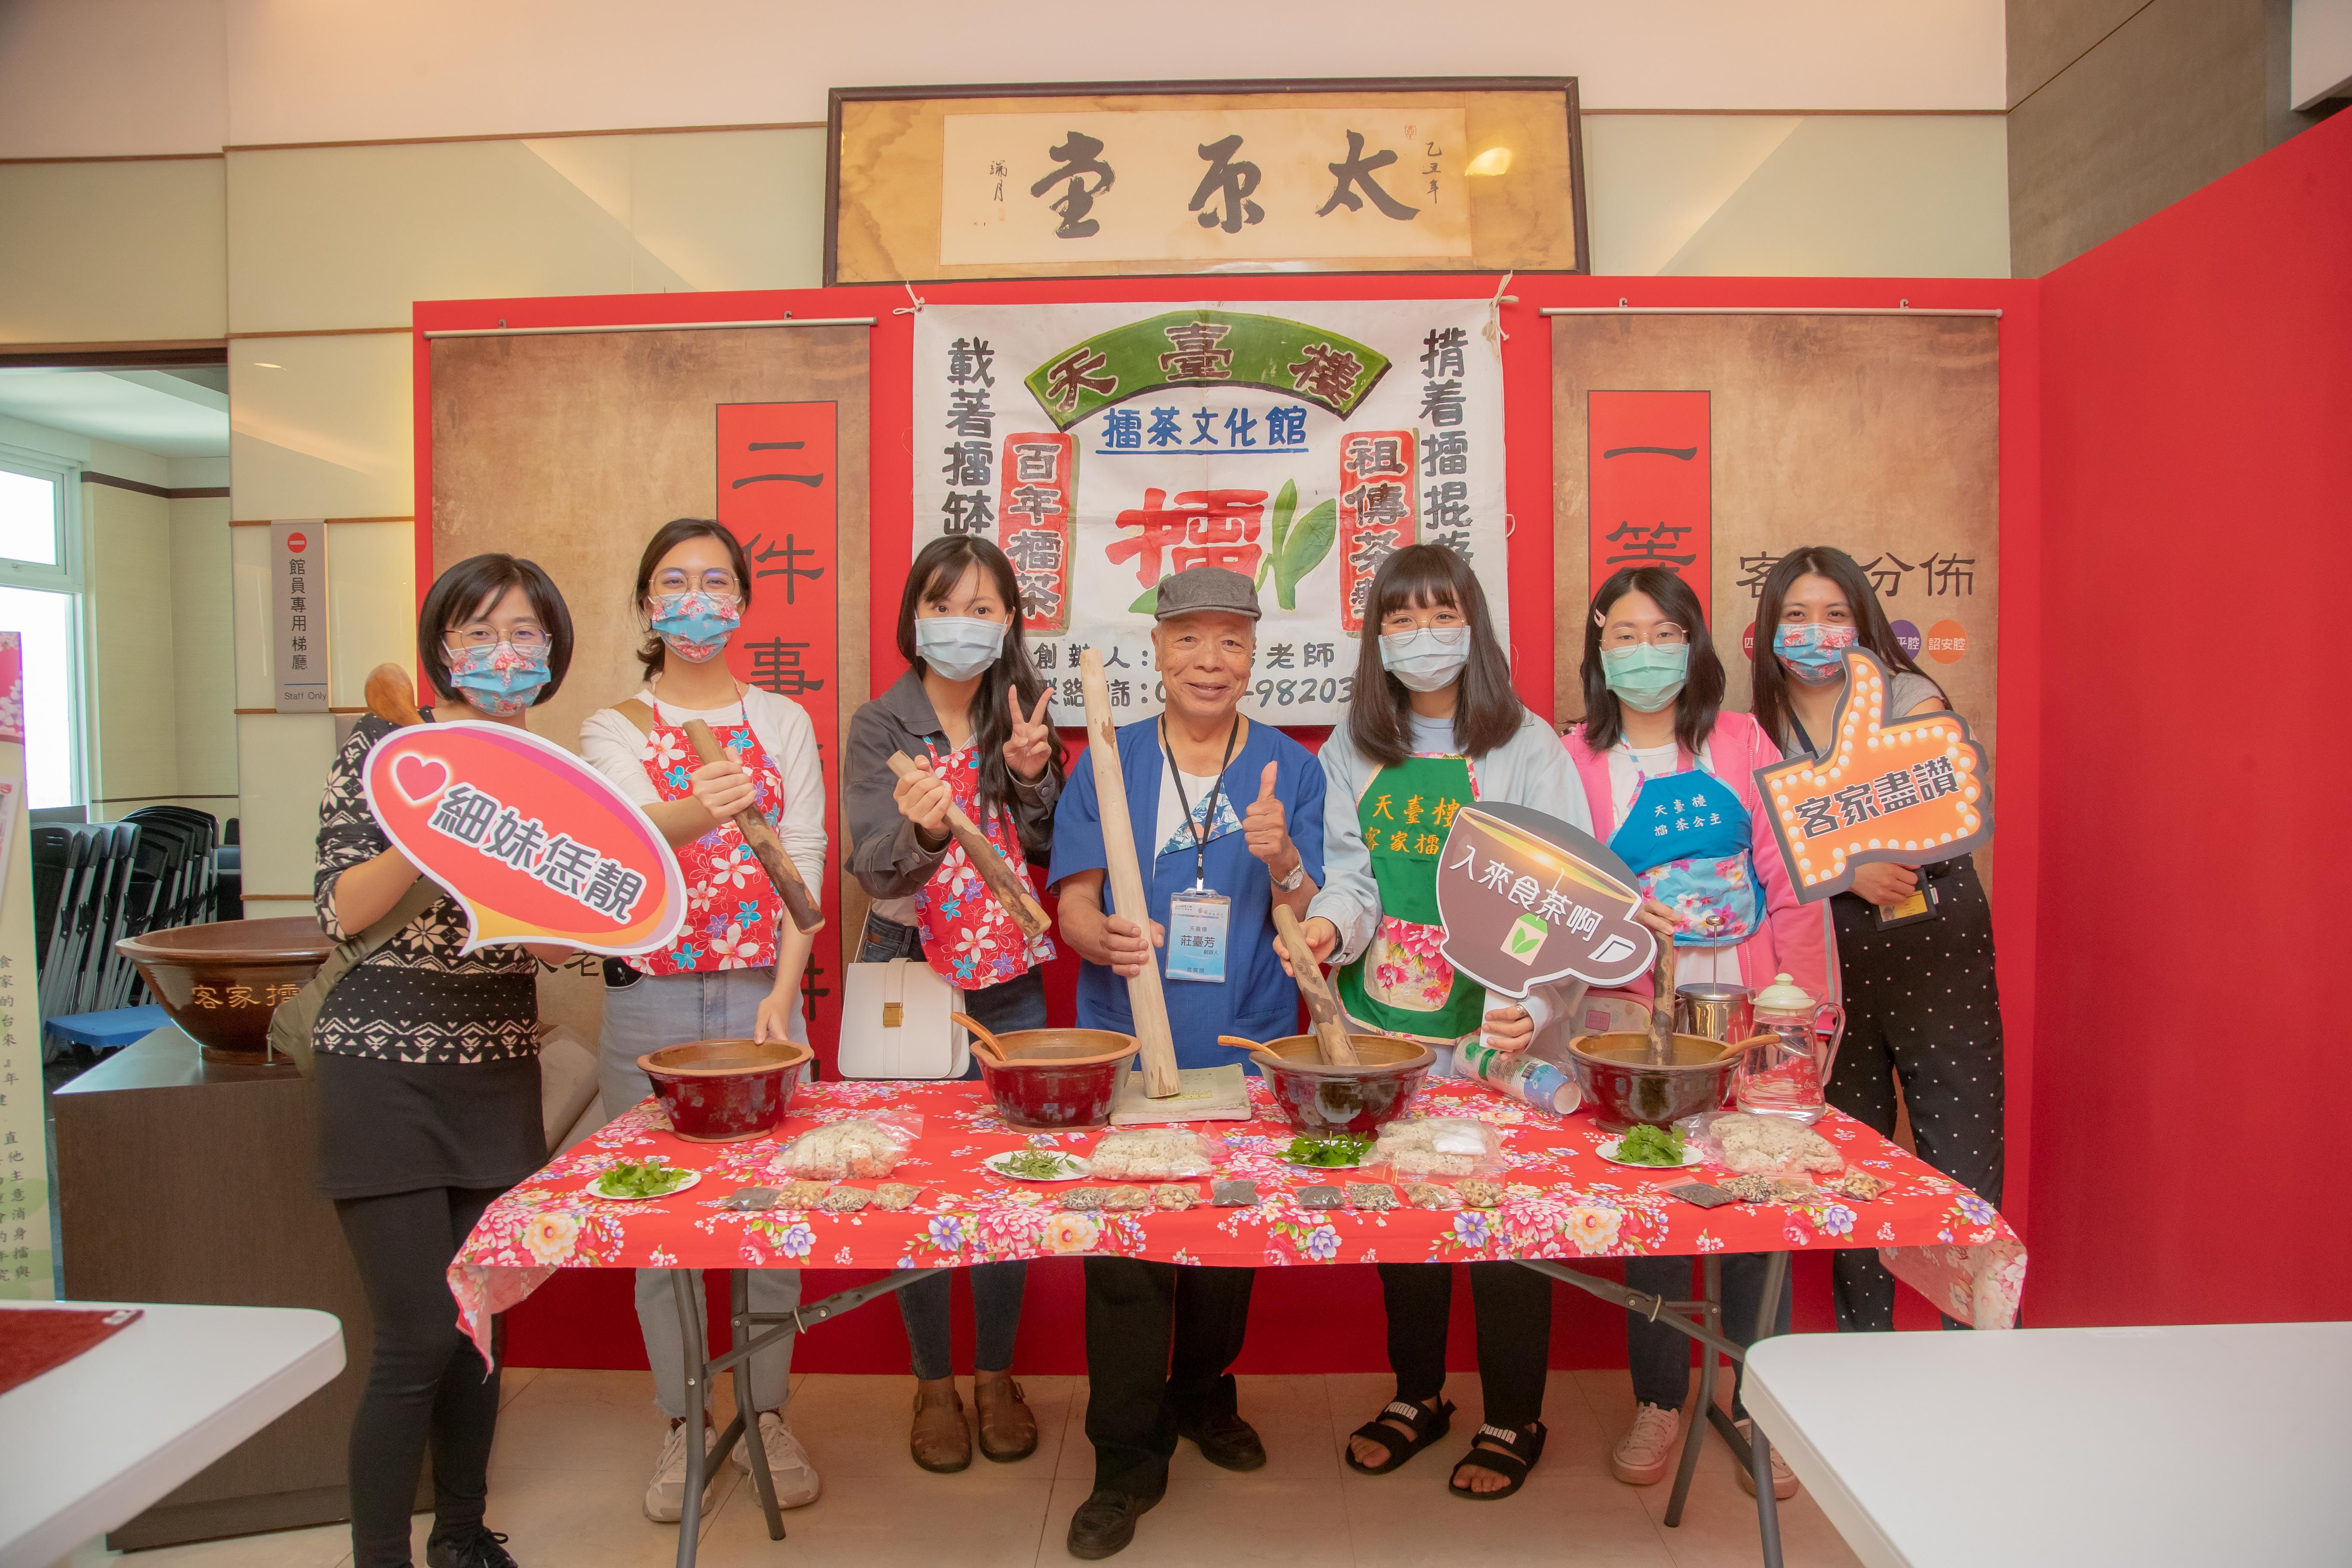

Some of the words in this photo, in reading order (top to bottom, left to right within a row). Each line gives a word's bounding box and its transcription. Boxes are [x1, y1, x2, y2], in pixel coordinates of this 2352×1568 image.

[1422, 141, 1442, 205] 乙丑年
[1103, 406, 1308, 448] 擂茶文化館
[1004, 442, 1063, 619] 百年擂茶
[1105, 487, 1268, 588] 擂
[732, 441, 825, 695] 二件事
[1736, 551, 1976, 598] 客分佈
[289, 558, 308, 671] 館員專用梯廳
[1266, 642, 1334, 670] 老師
[1928, 637, 1966, 651] 詔安腔
[284, 692, 304, 700] Staff
[307, 692, 327, 701] Only
[1372, 793, 1461, 828] 天臺樓
[1654, 793, 1708, 817] 天臺樓
[1794, 755, 1961, 840] 客家盡讚
[1654, 812, 1722, 836] 擂茶公主
[430, 784, 645, 922] 細妹恁靚
[1449, 844, 1605, 942] 入來食茶啊
[1180, 934, 1216, 948] 莊臺芳
[1384, 1401, 1418, 1420] PUMA
[1478, 1423, 1517, 1445] PUMA
